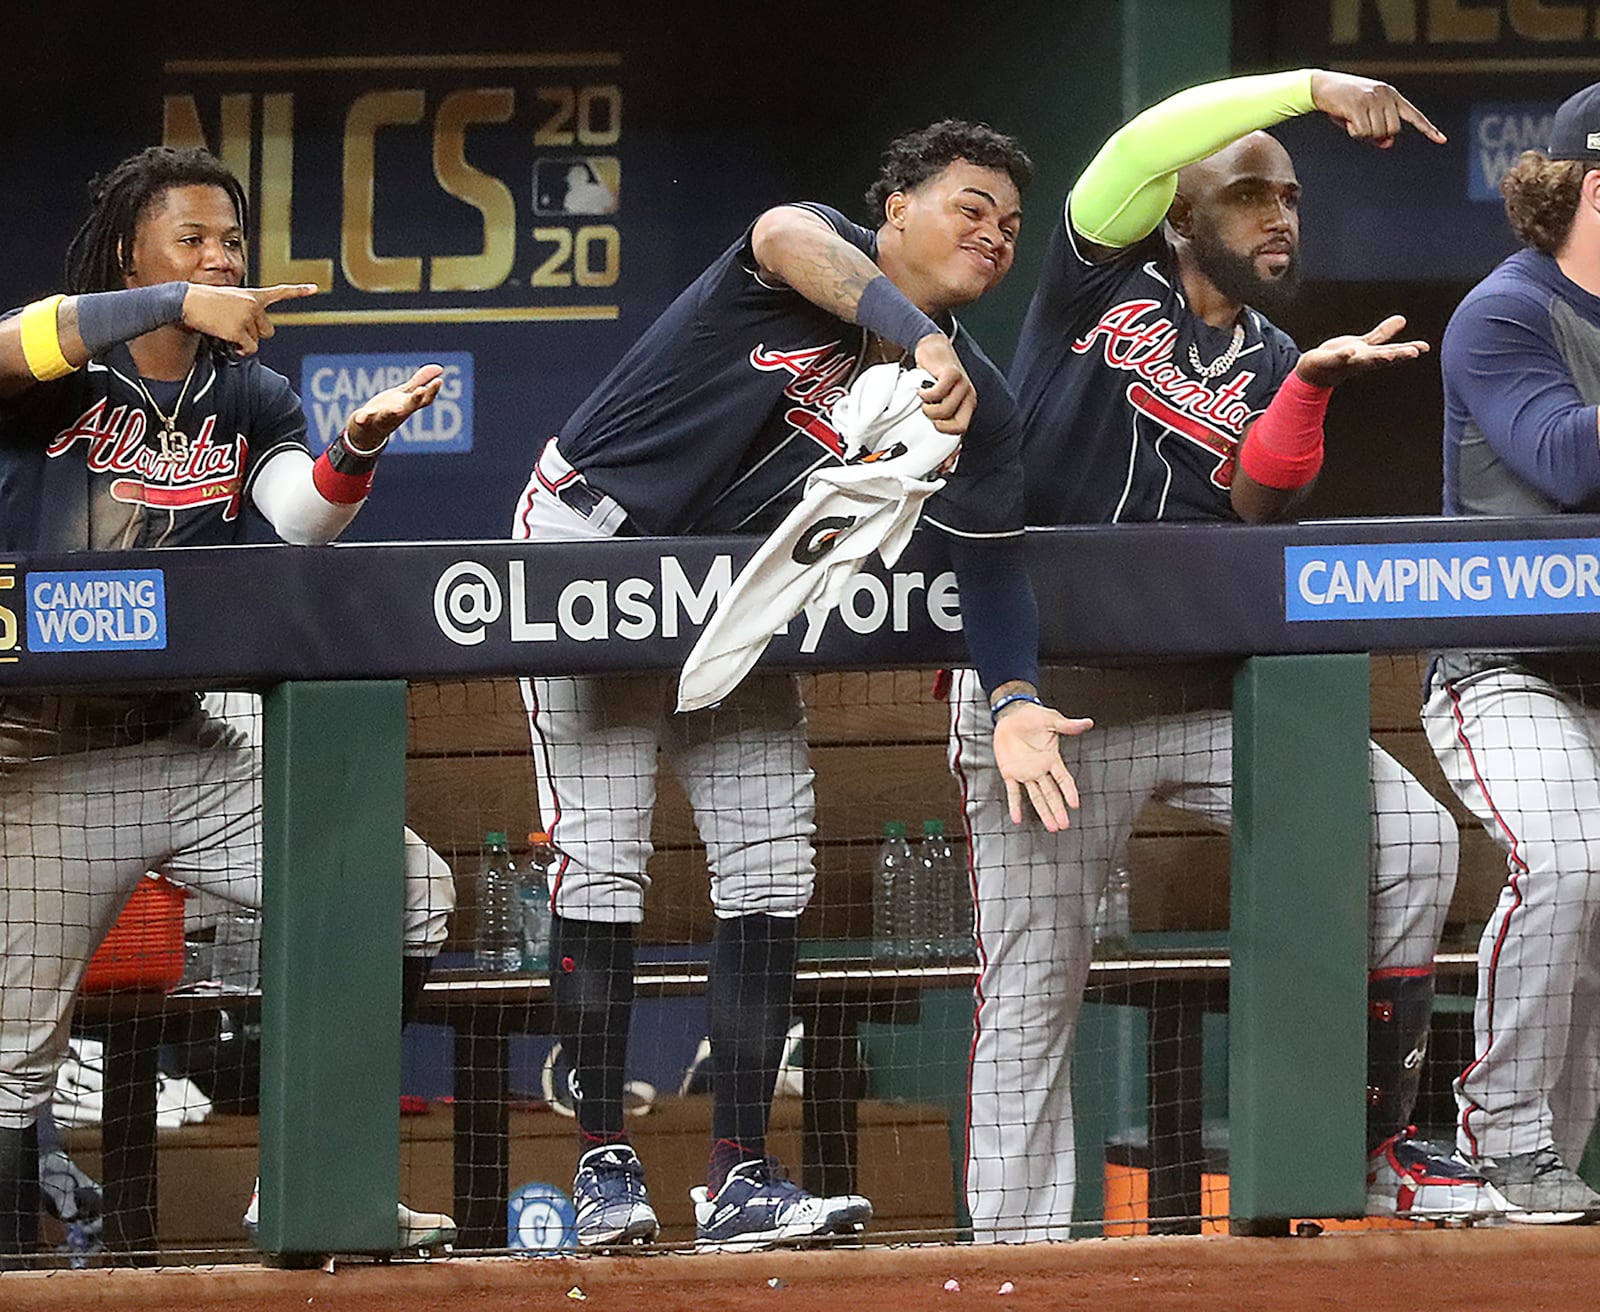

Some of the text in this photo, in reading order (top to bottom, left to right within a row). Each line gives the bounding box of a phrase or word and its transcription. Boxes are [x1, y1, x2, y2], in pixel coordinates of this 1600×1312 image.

[534, 84, 622, 147] 20
[530, 225, 621, 288] 20
[310, 365, 463, 402] CAMPG
[1071, 299, 1256, 435] Atlanta
[46, 396, 235, 483] Atlanta
[312, 400, 463, 444] WLD
[33, 579, 156, 610] CAMPING
[1299, 555, 1493, 606] CAMPING
[35, 608, 159, 644] WORLD
